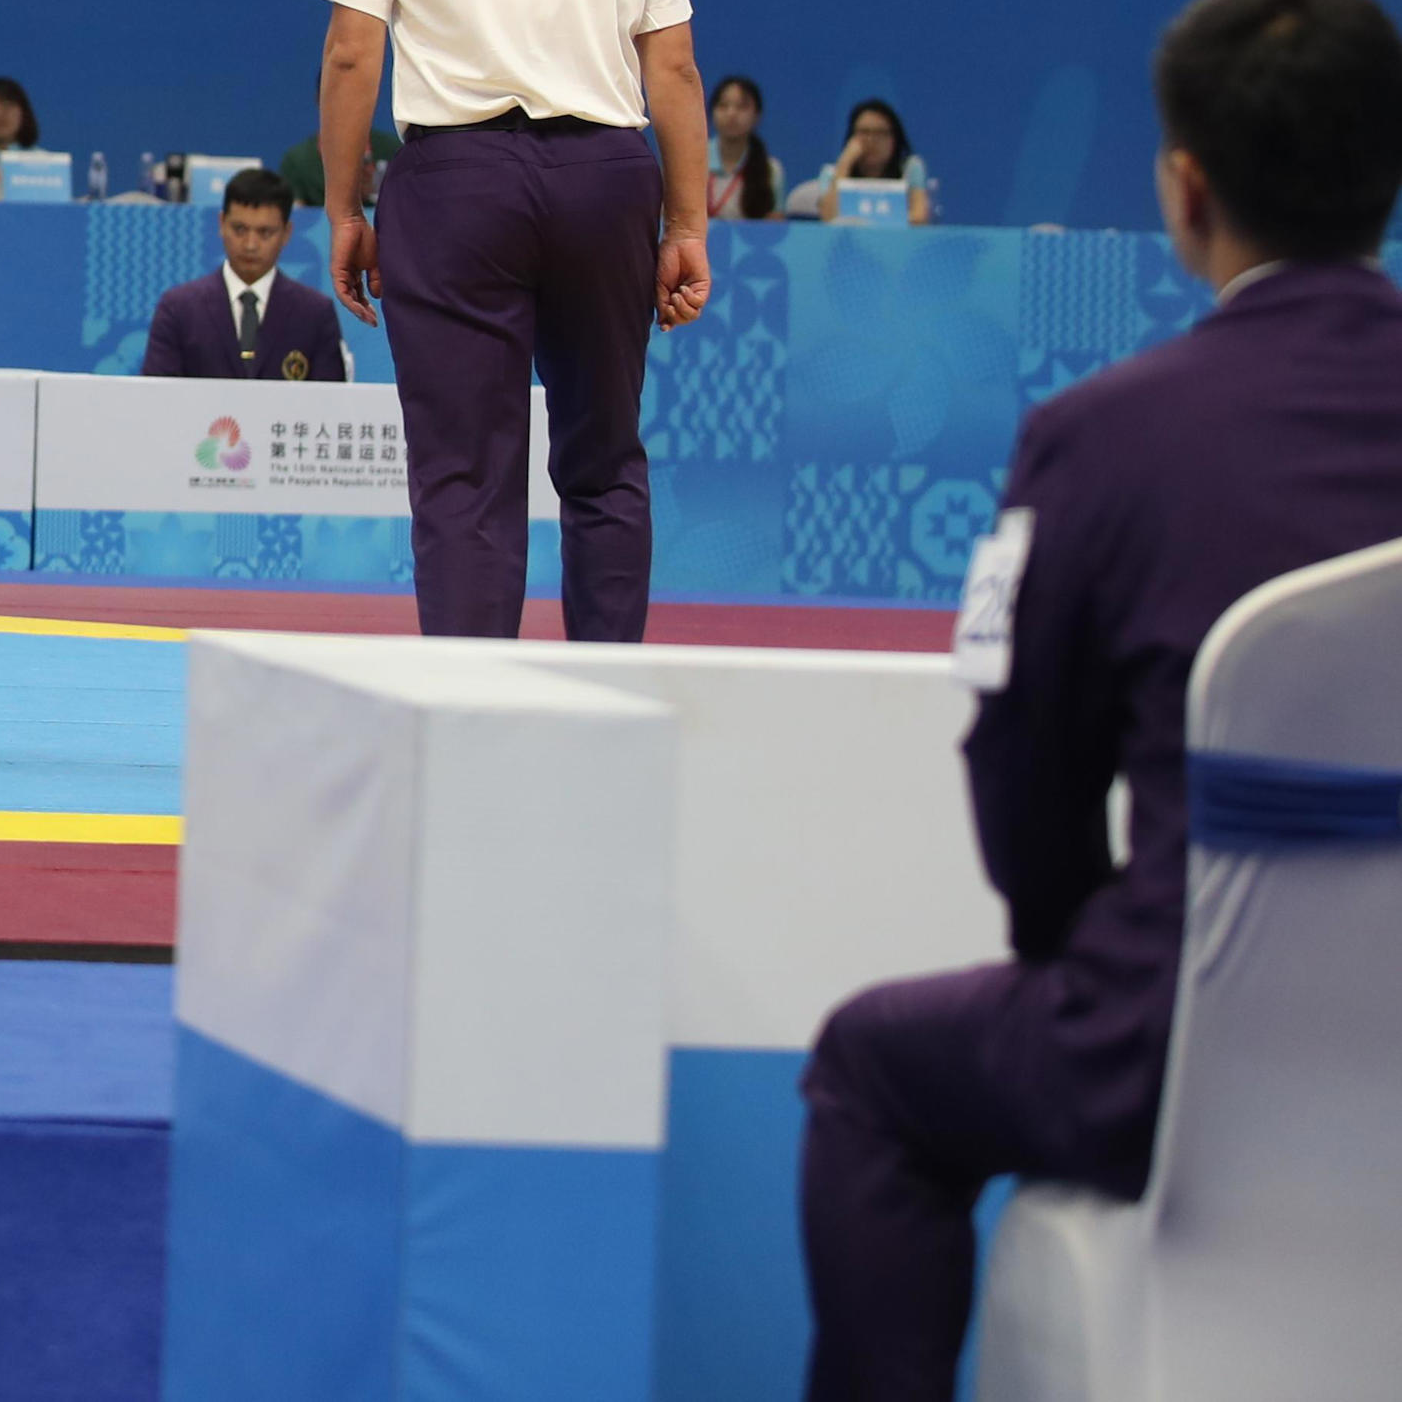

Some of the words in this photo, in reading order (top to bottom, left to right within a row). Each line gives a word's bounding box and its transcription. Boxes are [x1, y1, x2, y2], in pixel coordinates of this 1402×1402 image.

[271, 422, 397, 440] 中华人民共和
[270, 442, 407, 461] 第十五届运动
